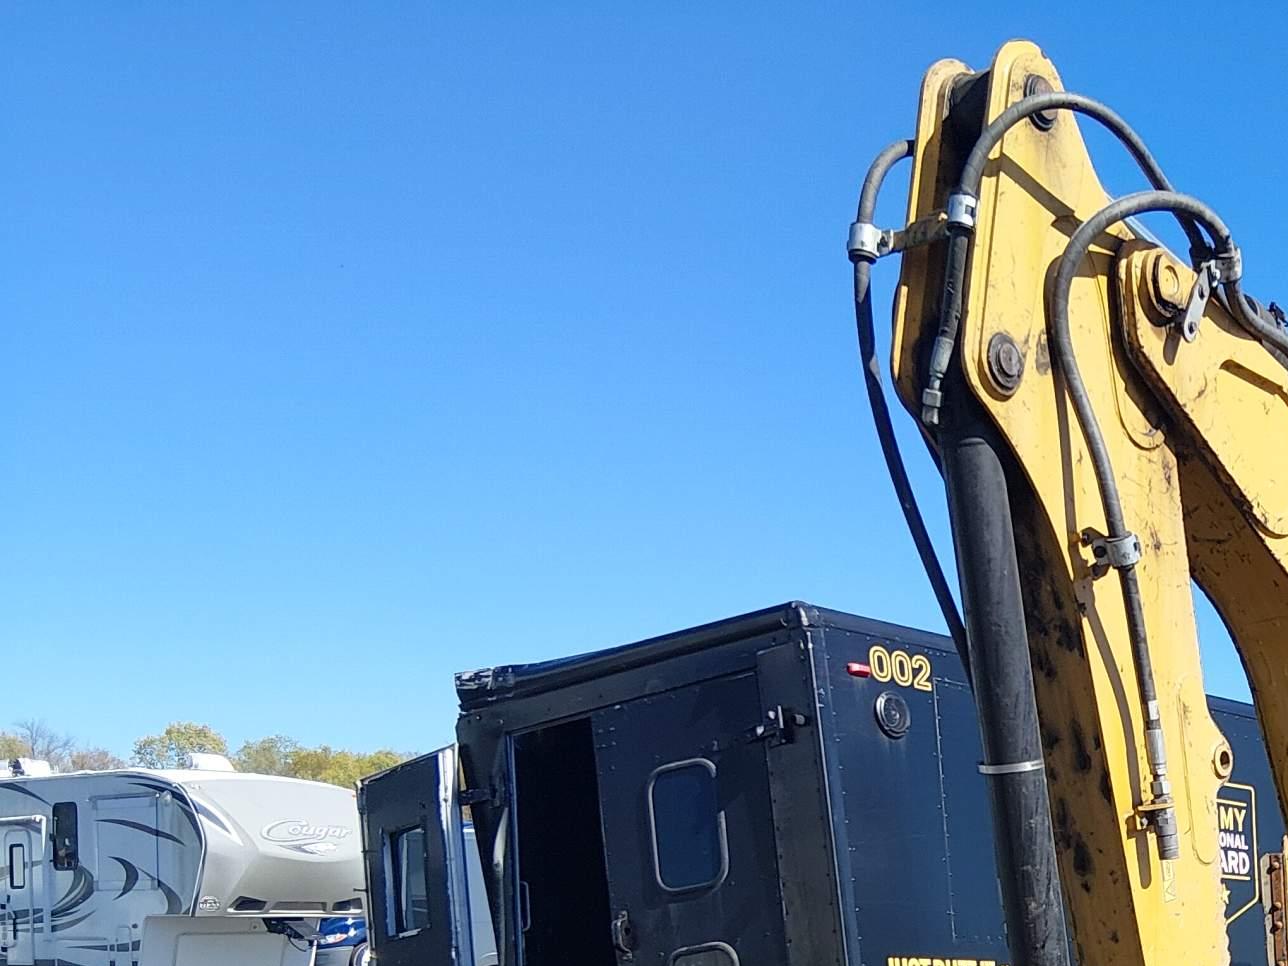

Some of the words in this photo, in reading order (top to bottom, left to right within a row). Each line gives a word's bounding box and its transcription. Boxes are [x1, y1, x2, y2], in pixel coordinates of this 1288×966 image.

[869, 645, 933, 692] 002
[261, 818, 353, 843] Cougar
[1219, 805, 1247, 832] MY
[1219, 831, 1249, 850] ONAL
[1220, 849, 1251, 875] ARD
